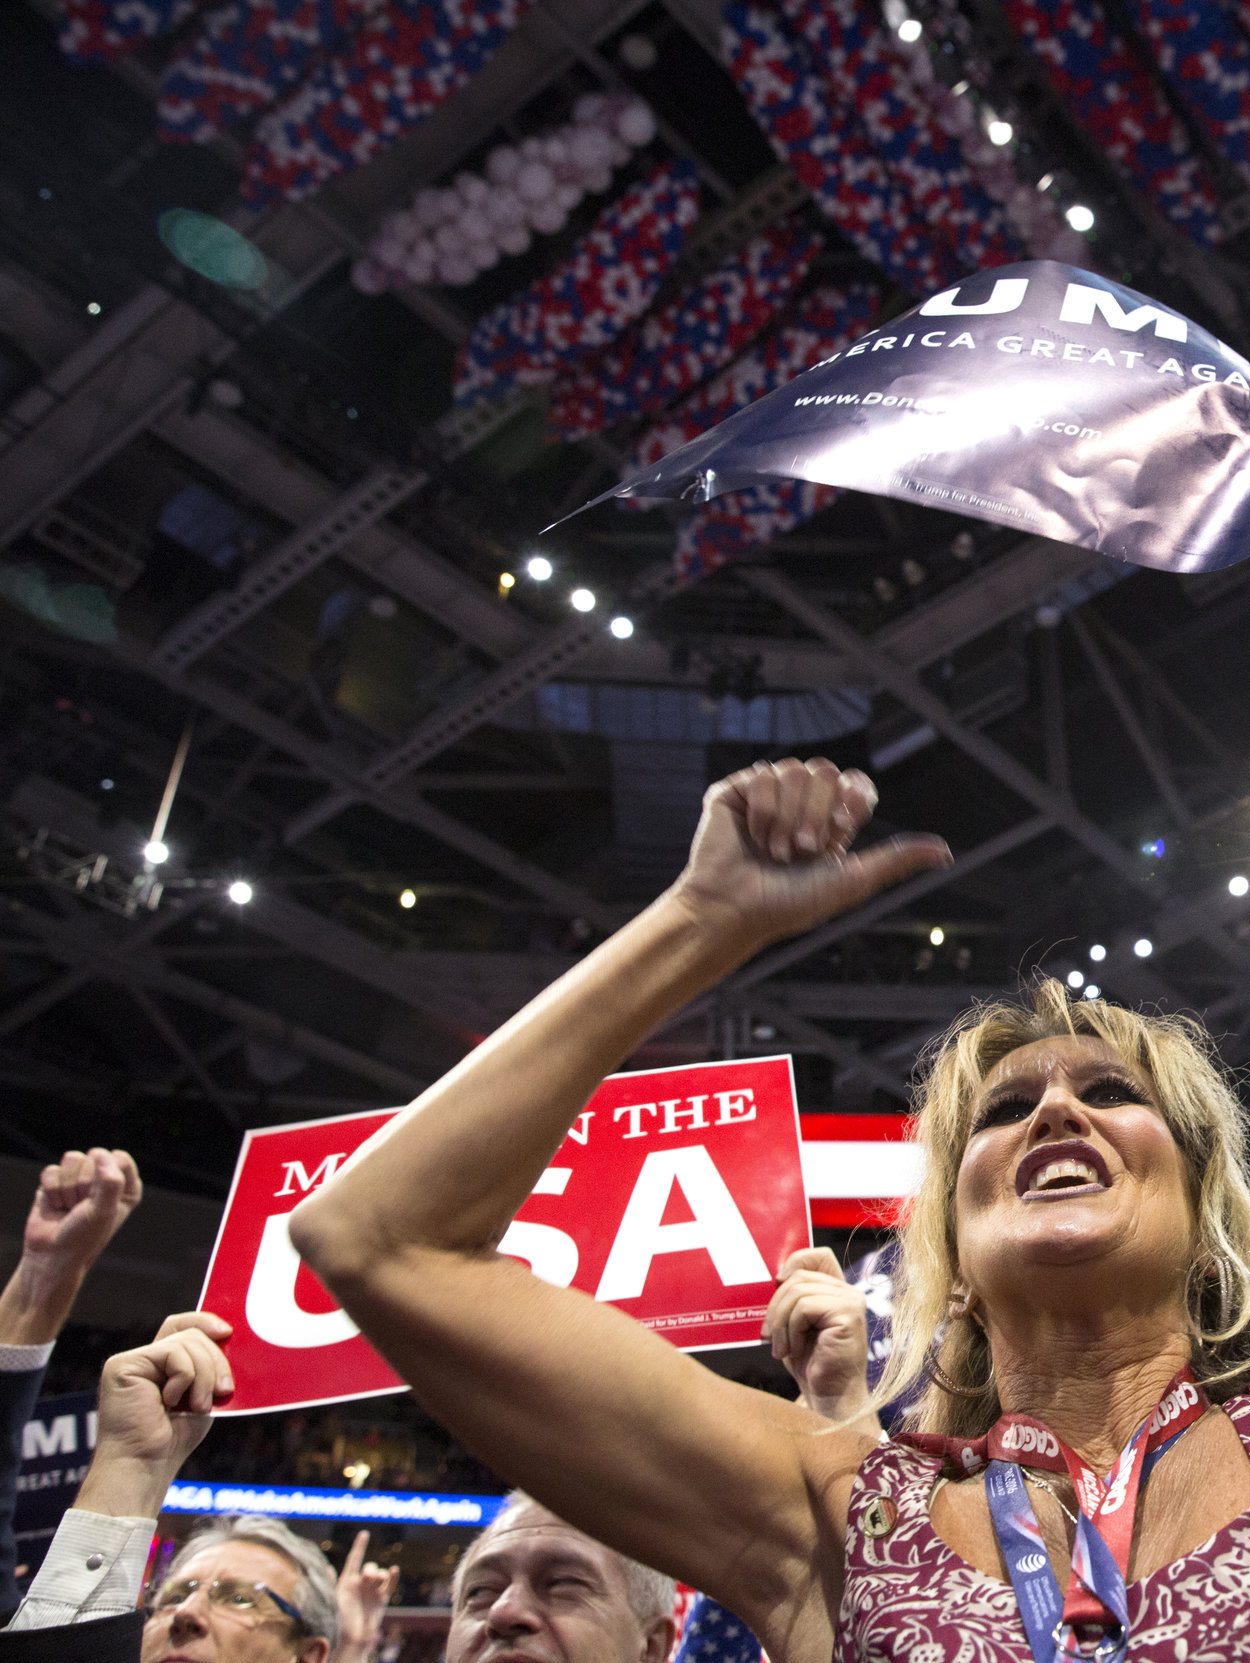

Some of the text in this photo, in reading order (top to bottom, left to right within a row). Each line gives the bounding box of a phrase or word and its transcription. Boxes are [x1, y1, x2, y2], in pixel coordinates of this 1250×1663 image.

[808, 331, 976, 372] MERICA
[997, 335, 1145, 369] GREAT
[613, 1088, 758, 1140] THE
[656, 1319, 667, 1327] for
[667, 1318, 678, 1328] by
[678, 1314, 705, 1325] Donald
[712, 1312, 736, 1322] Trump
[736, 1310, 747, 1319] for
[1149, 1381, 1199, 1436] CAGOP
[1001, 1422, 1060, 1458] CAGOP
